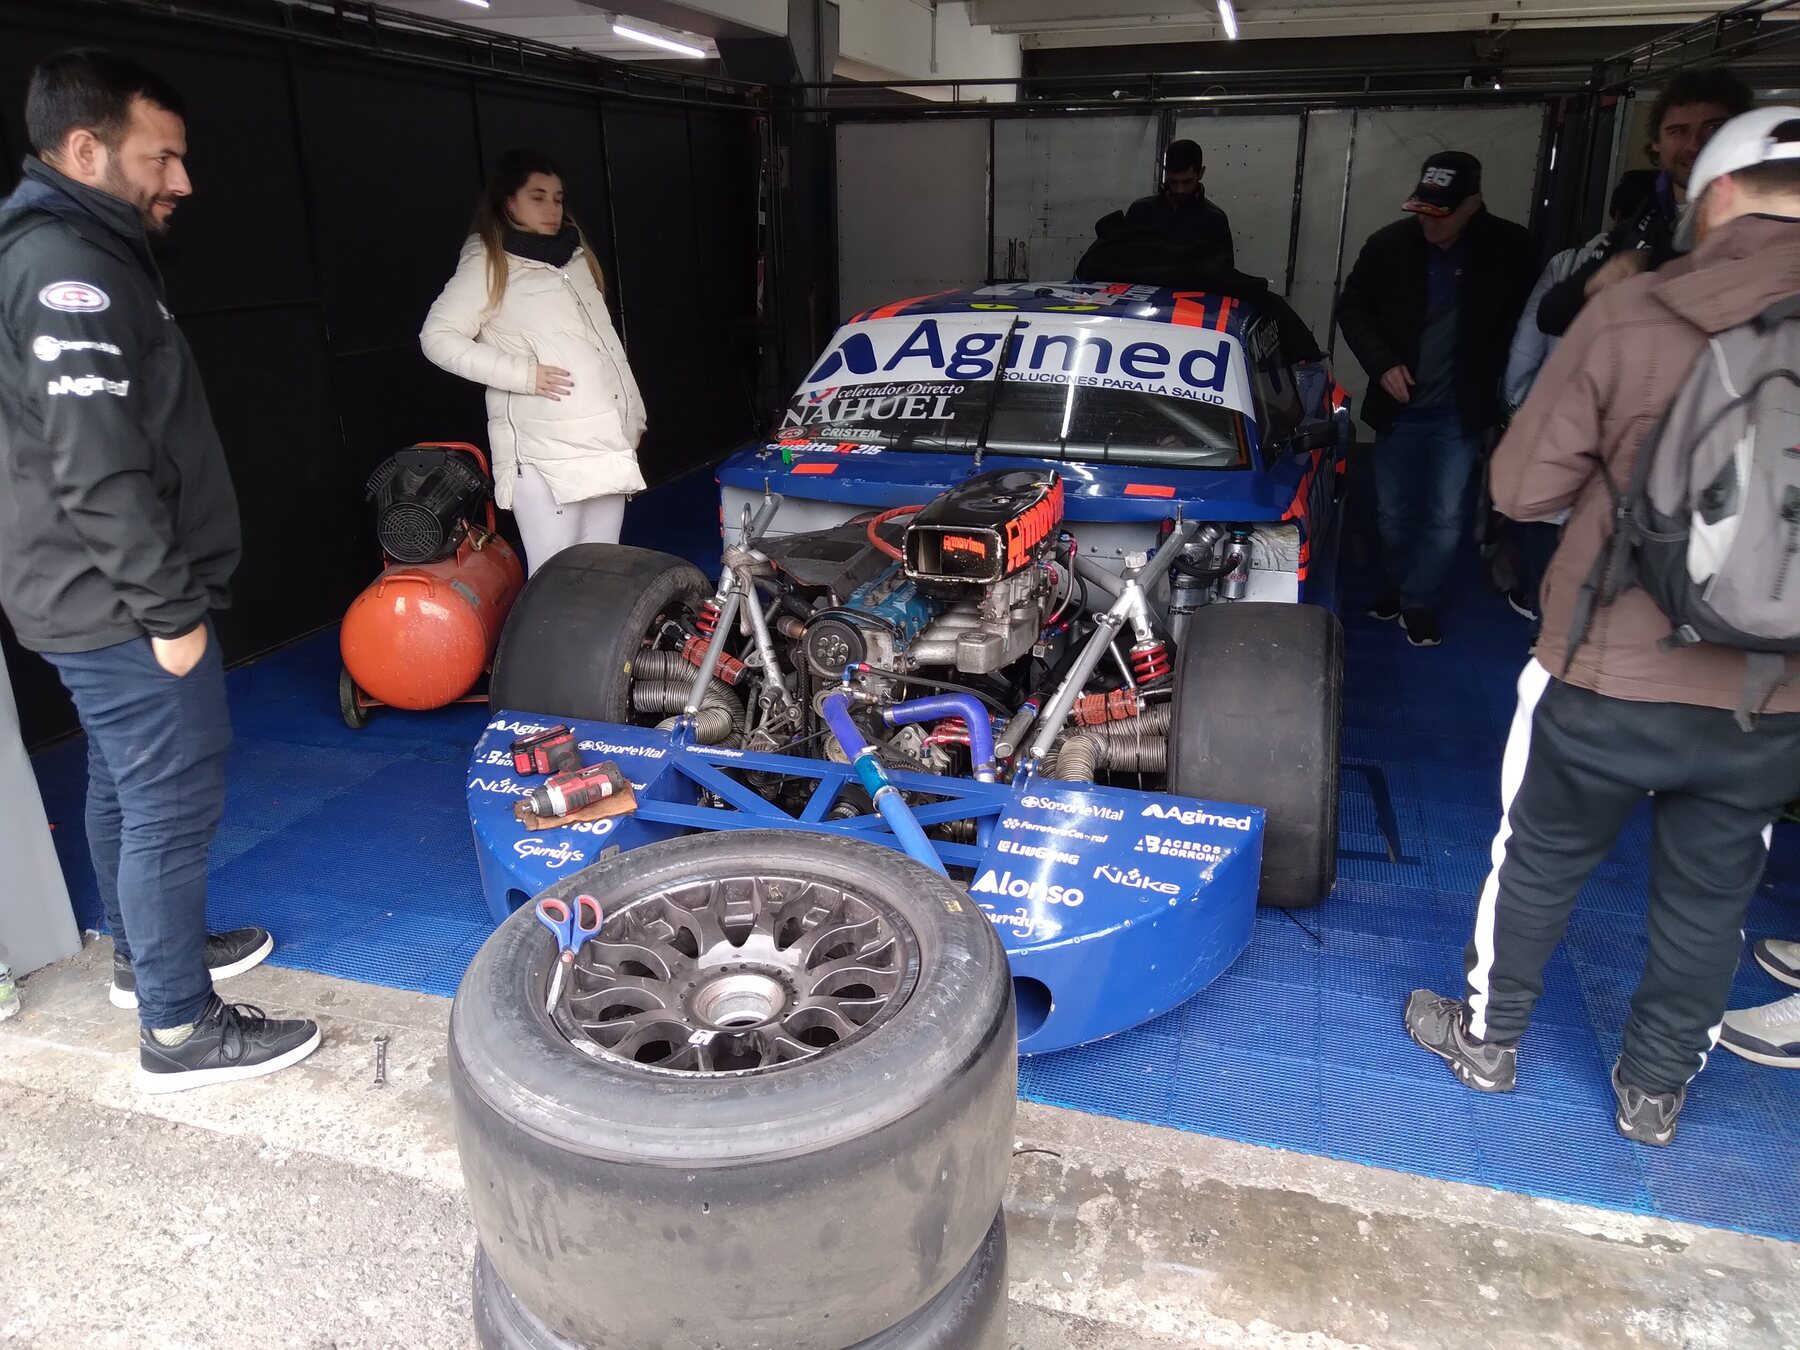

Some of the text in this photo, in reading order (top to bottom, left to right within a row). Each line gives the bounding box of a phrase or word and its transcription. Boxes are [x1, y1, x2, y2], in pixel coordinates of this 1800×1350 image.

[883, 319, 1231, 392] Agimed
[834, 382, 965, 400] celerador Directo
[1001, 371, 1225, 405] SOLUCIONES PARA LA SALUD
[778, 395, 956, 430] NAHUEL
[821, 427, 882, 439] CRISTEM
[505, 720, 576, 735] Agi
[1160, 805, 1252, 832] Agimed
[1162, 838, 1222, 855] ACEROS
[971, 869, 1084, 907] Alonso
